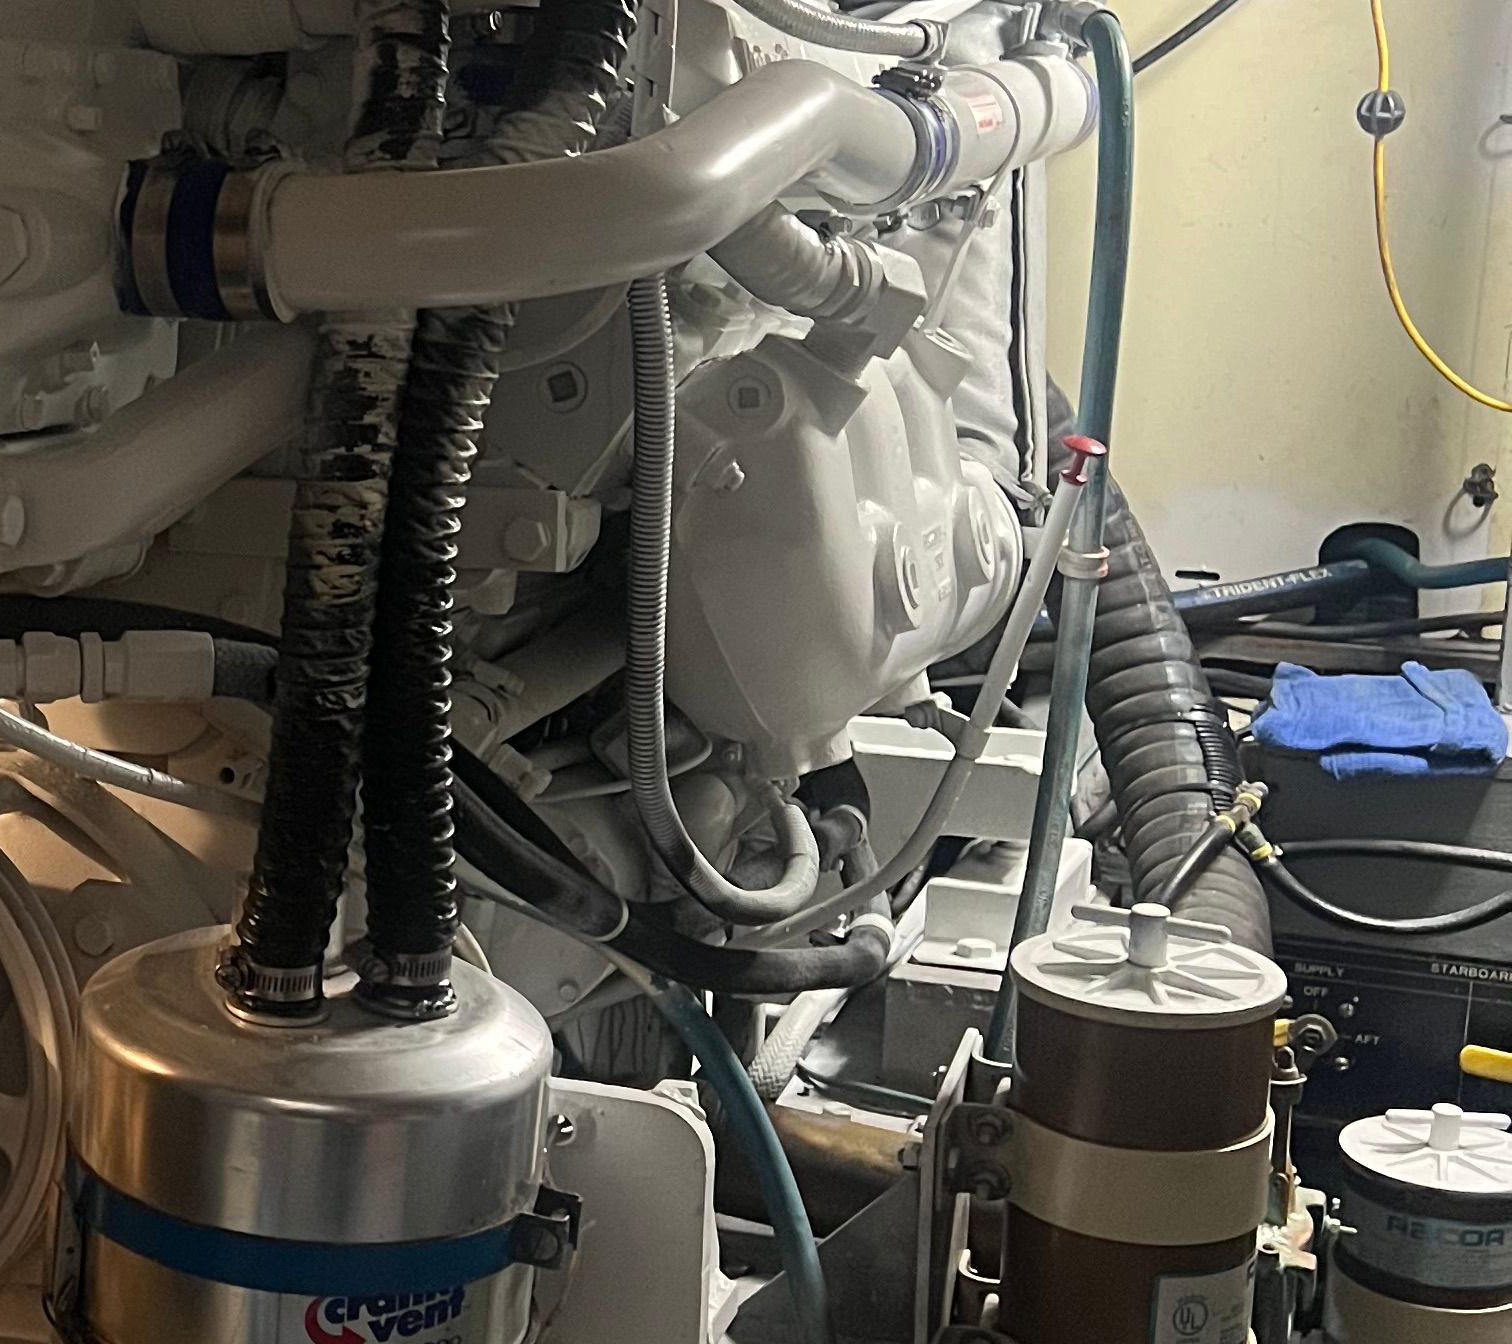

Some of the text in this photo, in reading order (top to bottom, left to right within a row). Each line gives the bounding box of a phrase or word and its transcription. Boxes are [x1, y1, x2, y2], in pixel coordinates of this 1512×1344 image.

[1212, 567, 1333, 599] TRIDENT-FLEX
[1294, 962, 1345, 978] SUPPLY
[1303, 985, 1328, 998] OFF
[1354, 1033, 1381, 1046] AFT
[368, 1285, 465, 1343] vent
